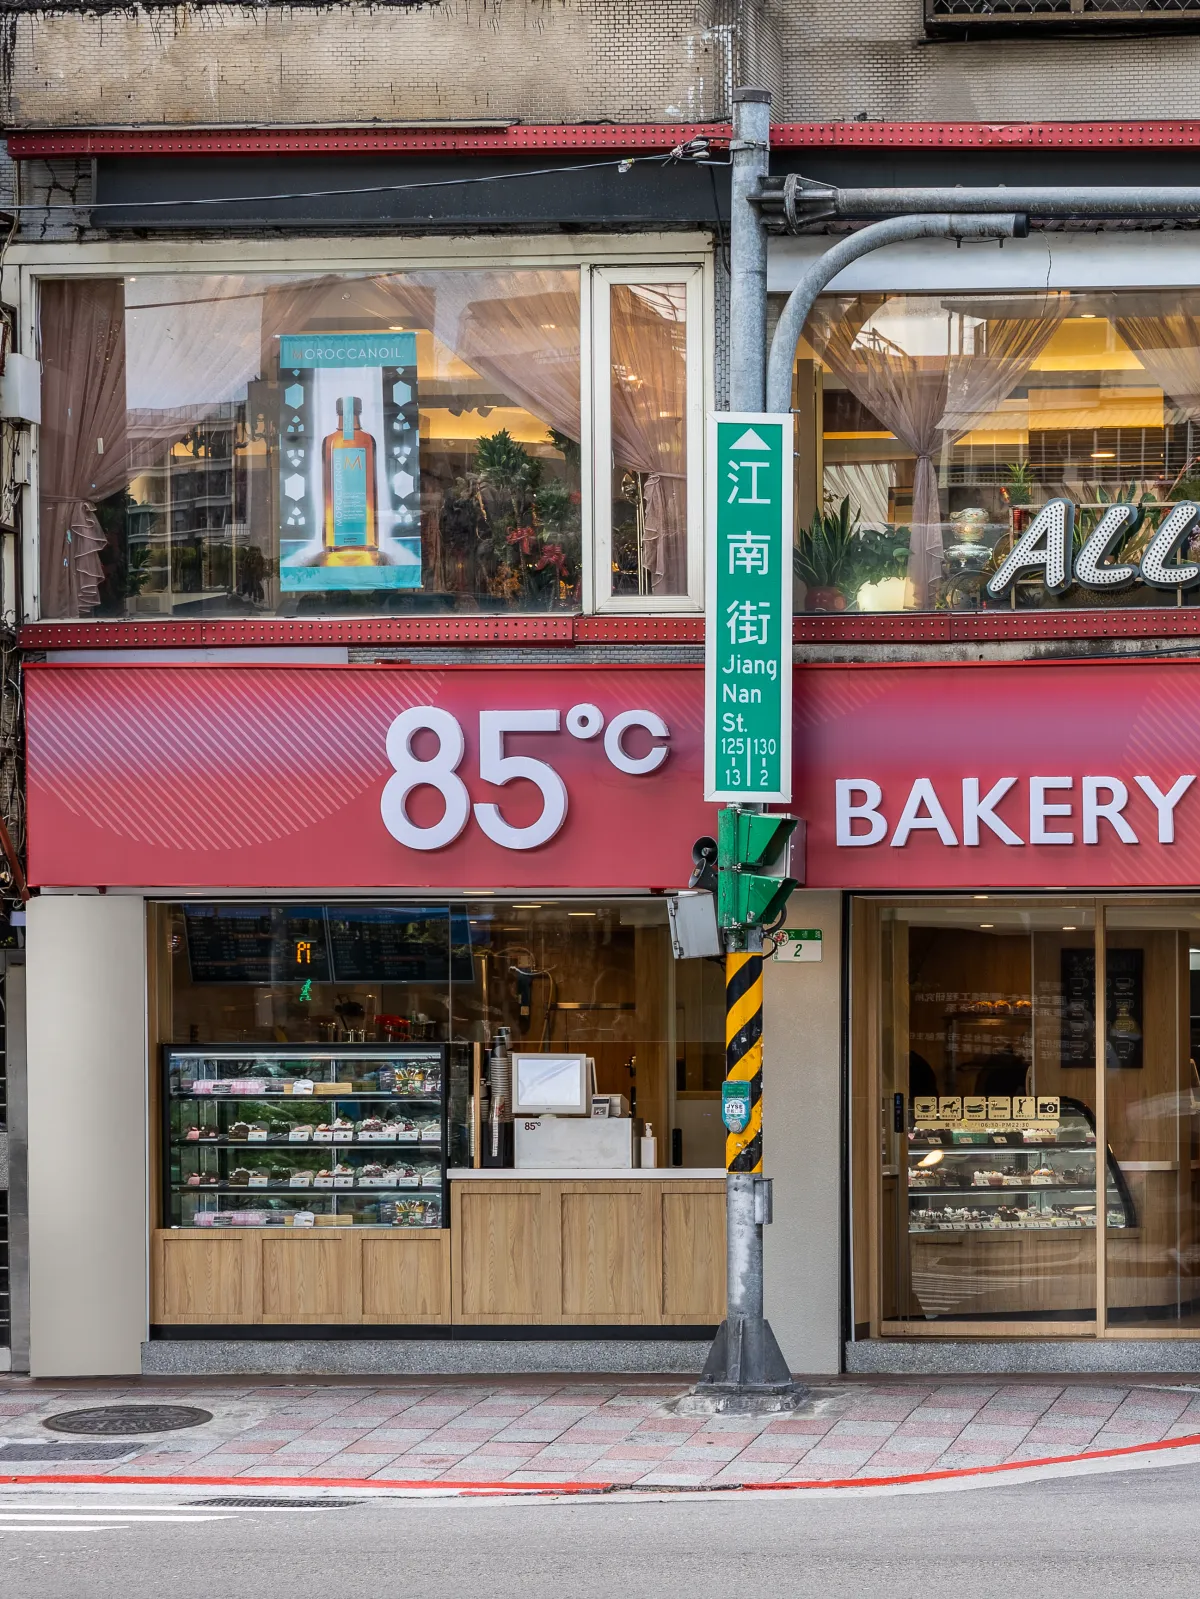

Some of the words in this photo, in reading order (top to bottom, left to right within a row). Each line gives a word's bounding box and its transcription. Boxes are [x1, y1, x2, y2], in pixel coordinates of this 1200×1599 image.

[726, 459, 771, 645] 江南街
[722, 654, 777, 681] Jiang
[722, 683, 762, 703] Nan
[722, 712, 748, 732] St.
[721, 737, 745, 755] 125
[754, 738, 777, 755] 130
[725, 769, 741, 786] 13
[760, 769, 769, 786] 2
[835, 774, 1197, 847] BAKERY
[793, 943, 803, 957] 2
